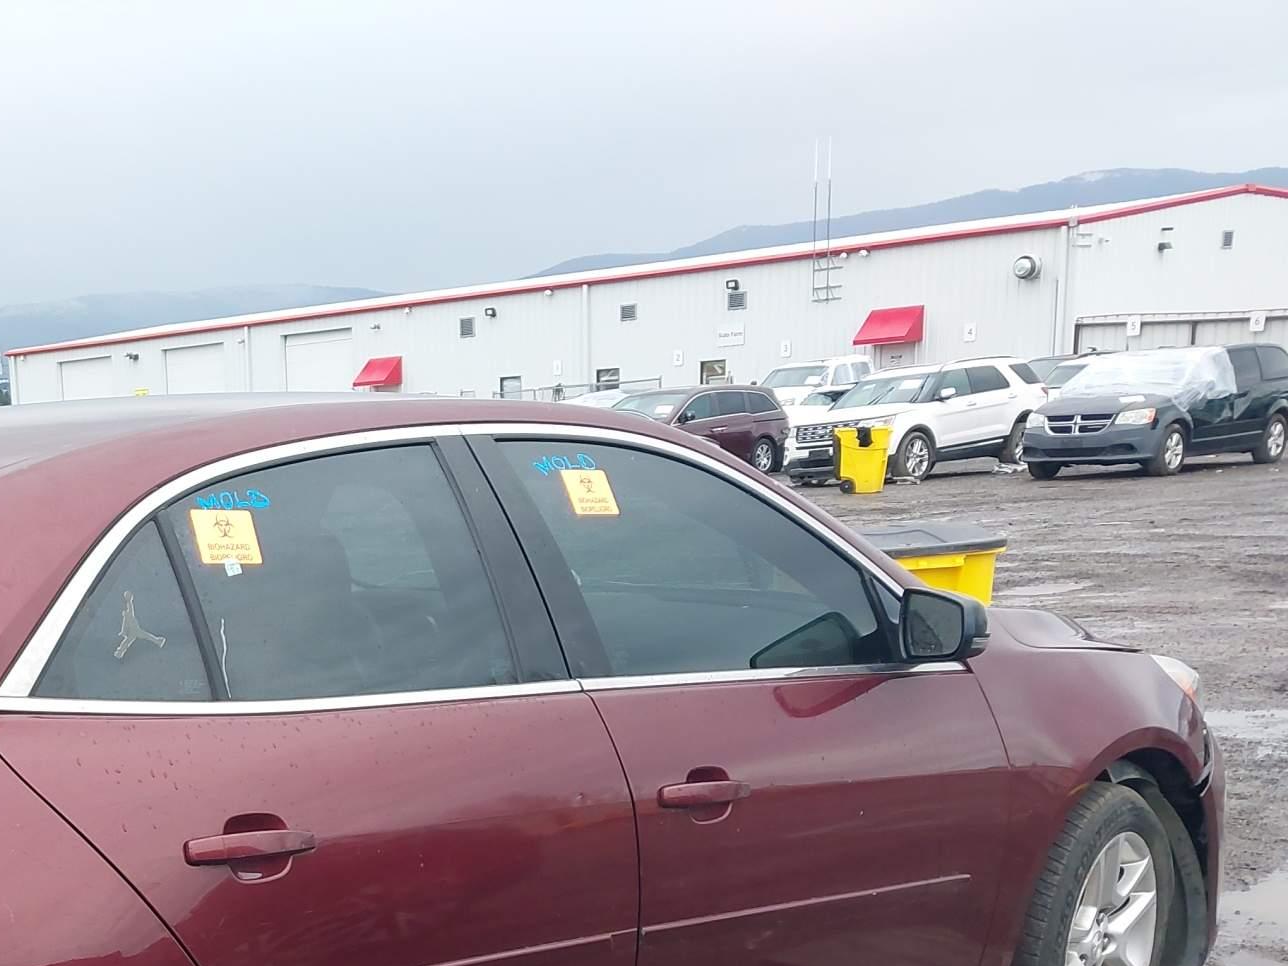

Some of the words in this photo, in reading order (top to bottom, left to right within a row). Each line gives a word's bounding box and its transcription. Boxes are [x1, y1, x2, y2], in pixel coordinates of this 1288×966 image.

[534, 453, 596, 476] MOLD
[197, 489, 270, 510] MOLD
[207, 543, 252, 552] BIOHAZARD
